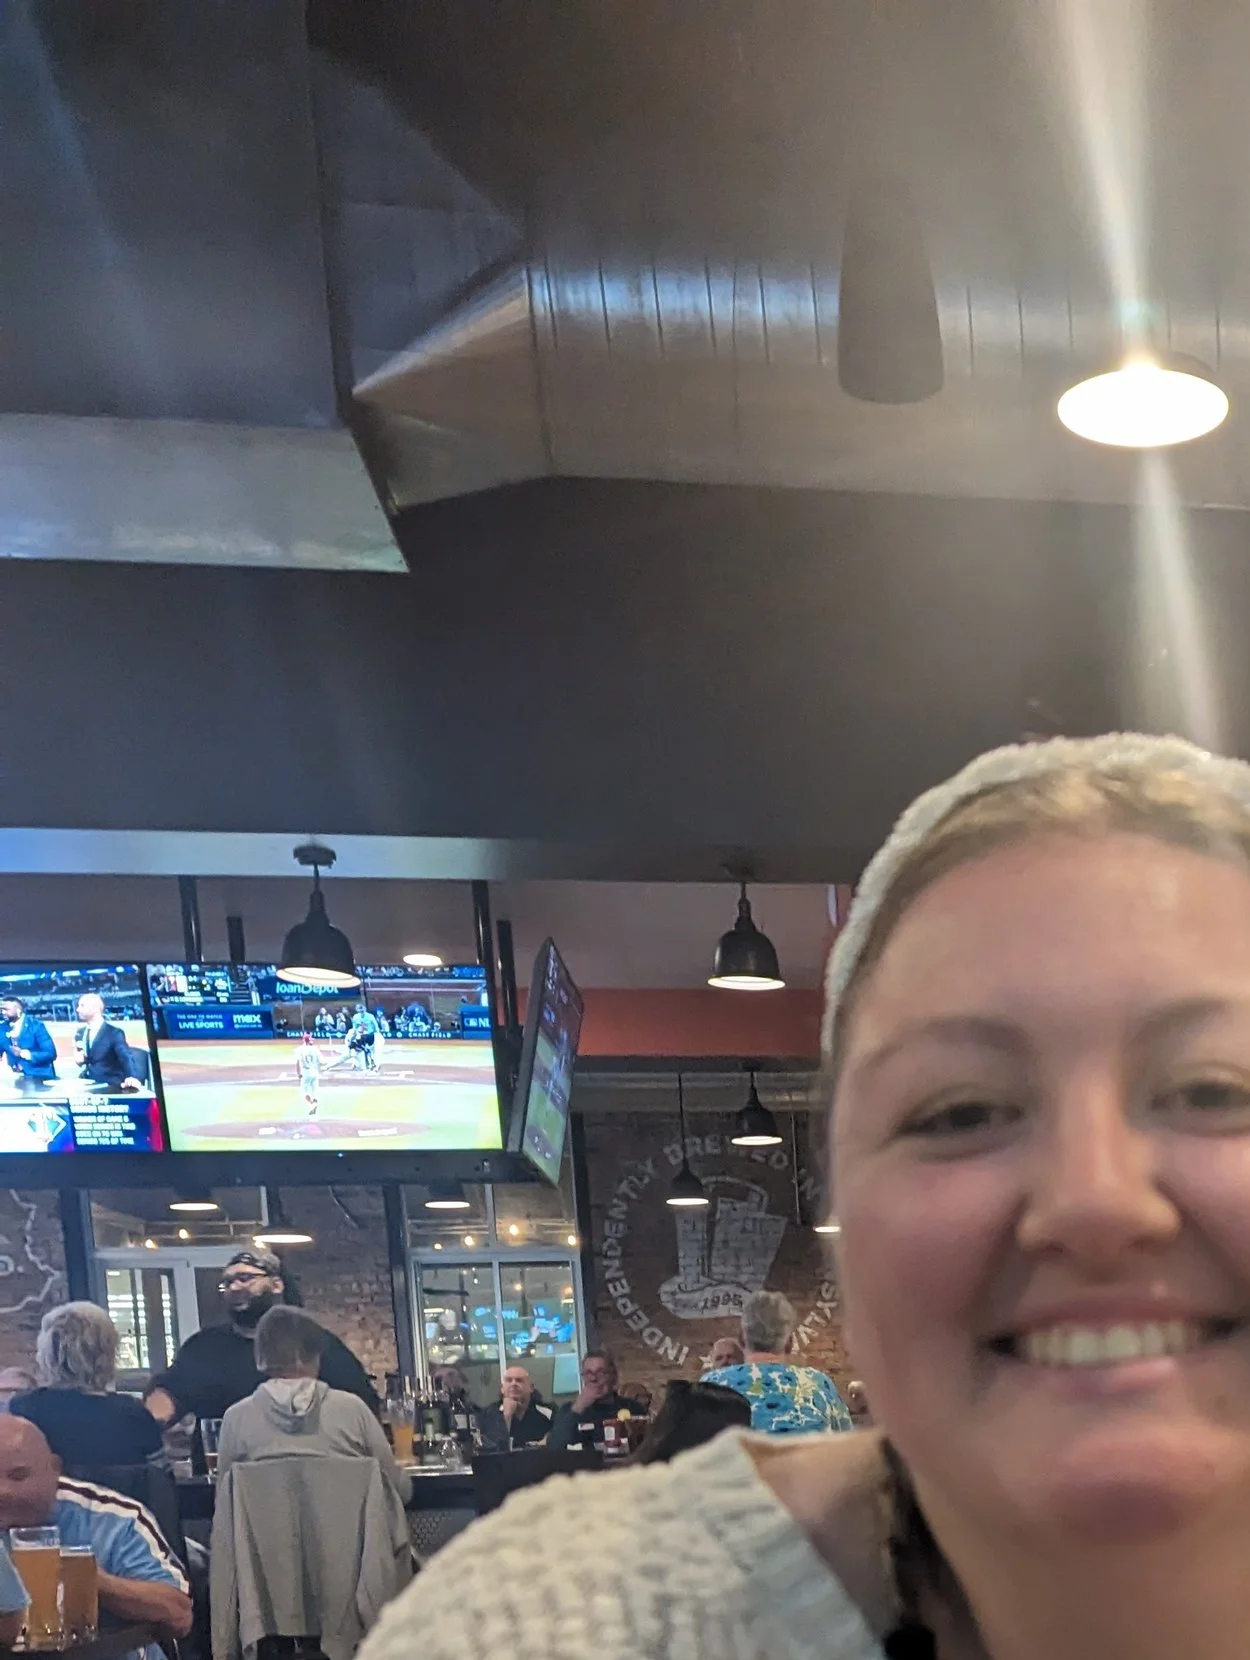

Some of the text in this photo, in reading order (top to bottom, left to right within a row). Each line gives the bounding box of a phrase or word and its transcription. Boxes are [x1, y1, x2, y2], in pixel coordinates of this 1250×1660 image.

[276, 981, 339, 996] loanDepot
[179, 1021, 224, 1029] LIVE SPORTS
[233, 1014, 262, 1024] max
[602, 1157, 690, 1366] INDEPENDENTLY
